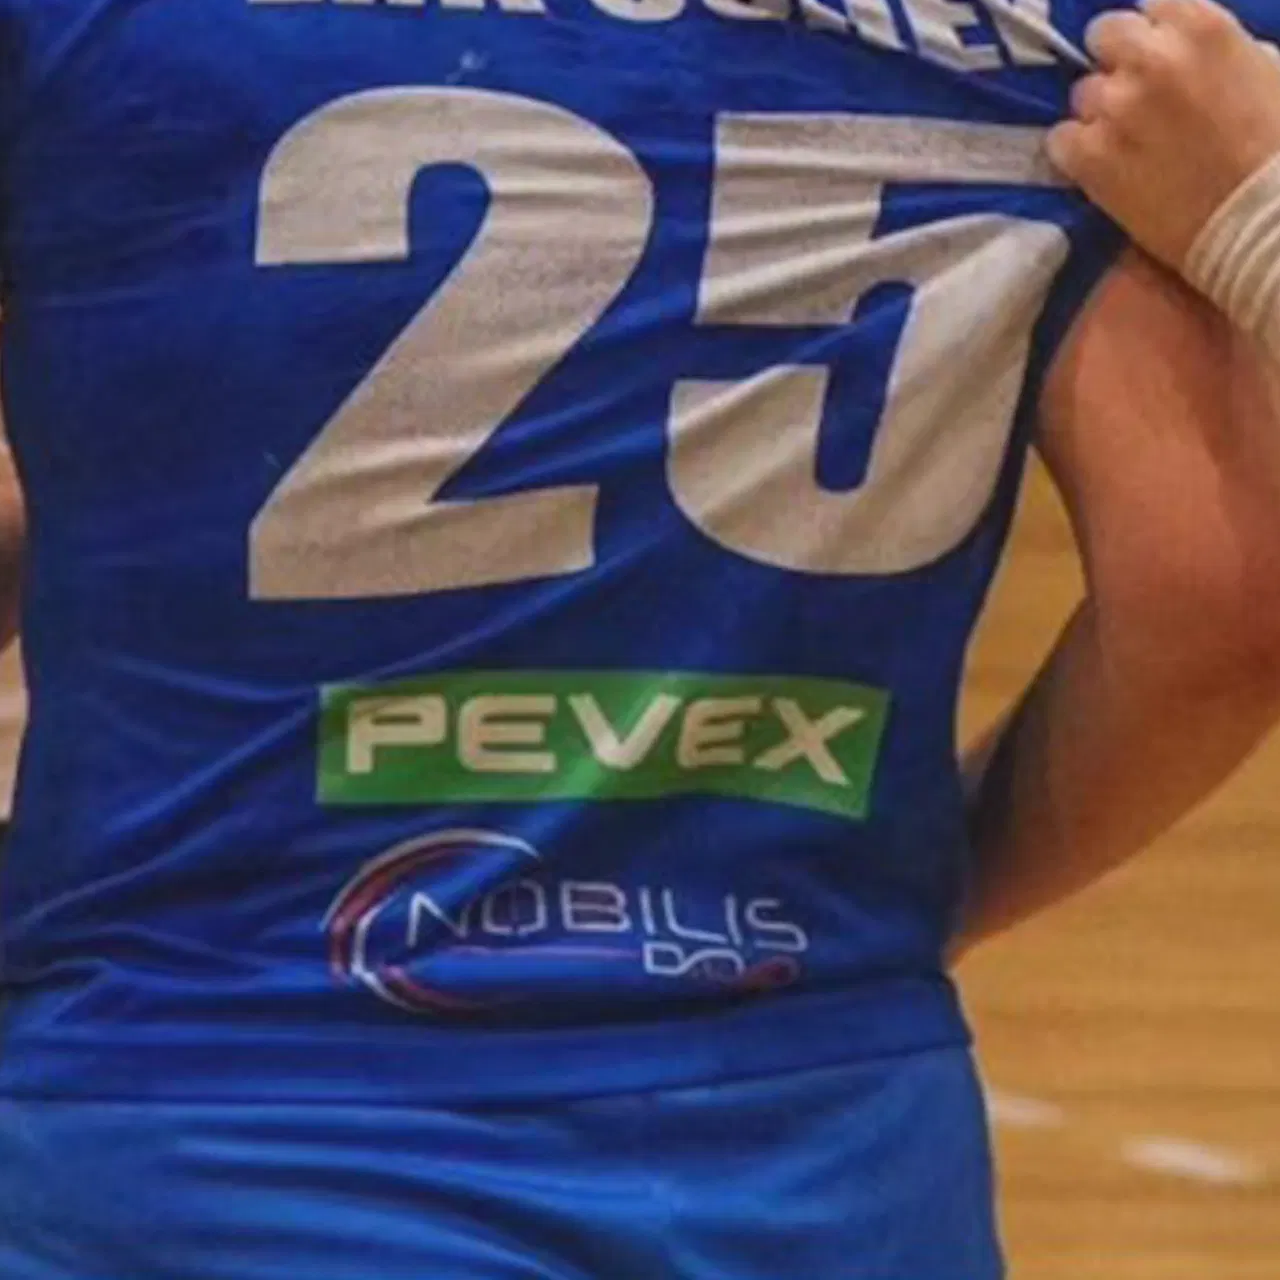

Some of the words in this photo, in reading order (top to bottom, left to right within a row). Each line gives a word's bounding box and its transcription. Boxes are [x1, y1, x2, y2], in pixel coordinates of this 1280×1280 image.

[249, 86, 1072, 600] 25
[345, 693, 864, 788] PEVEX
[406, 881, 808, 953] NOBILIS
